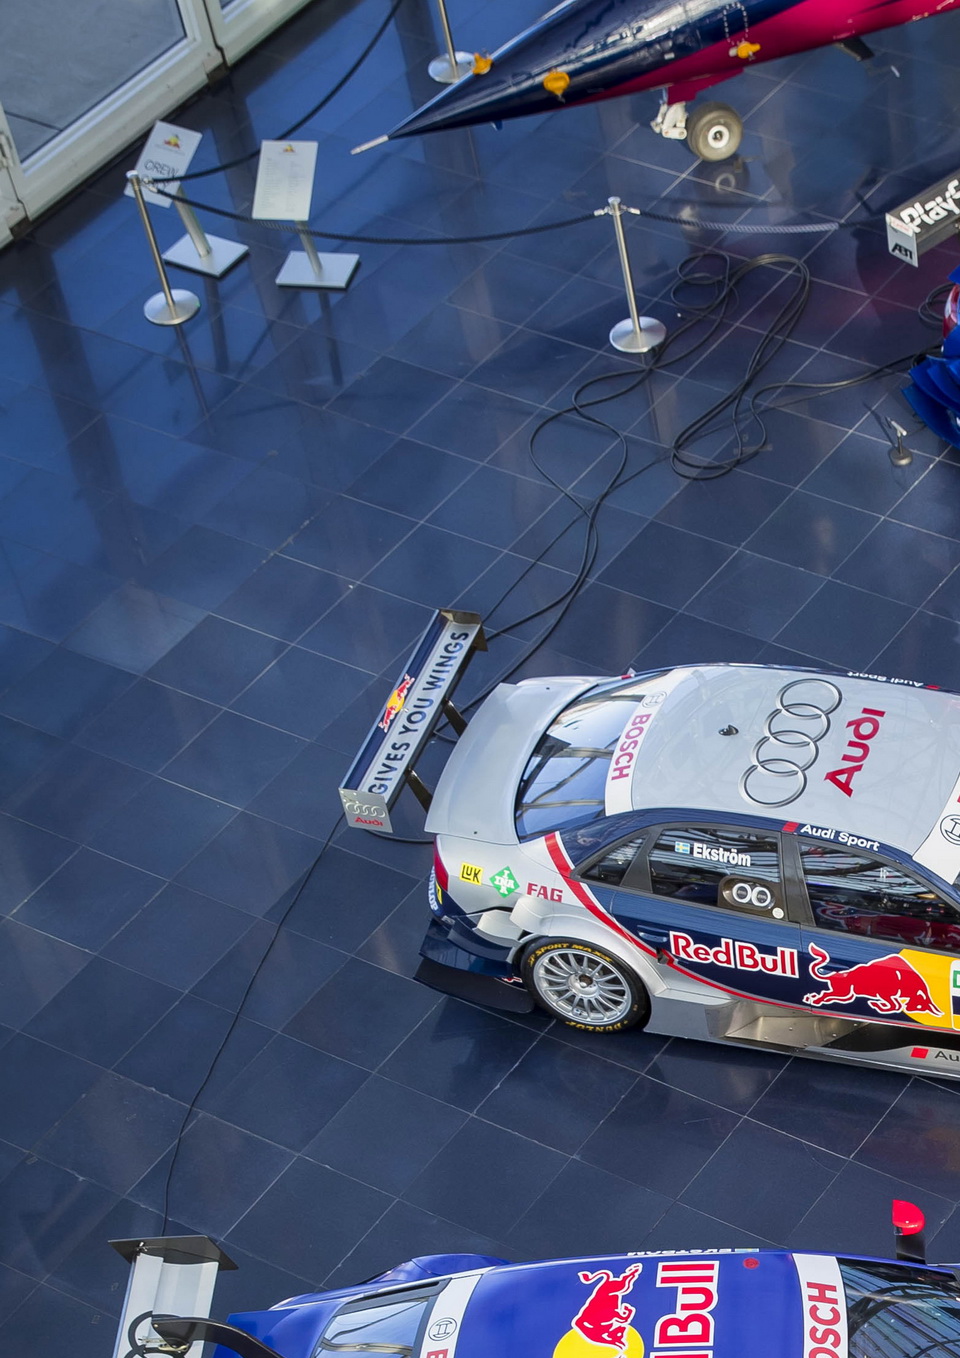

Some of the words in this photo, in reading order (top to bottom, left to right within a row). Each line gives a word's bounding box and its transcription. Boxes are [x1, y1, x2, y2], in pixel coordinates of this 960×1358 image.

[368, 739, 411, 794] GIVES
[399, 698, 434, 738] YOU
[422, 631, 469, 700] WINGS
[610, 713, 652, 781] BOSCH
[824, 707, 886, 798] Audi
[354, 816, 384, 827] Audi
[800, 823, 836, 839] Audi
[838, 832, 880, 852] Sport
[693, 842, 751, 867] Ekström
[527, 883, 563, 903] FAG
[536, 943, 569, 955] SPORT
[669, 931, 736, 968] Red
[735, 942, 799, 978] Bull
[655, 1261, 719, 1347] Bull
